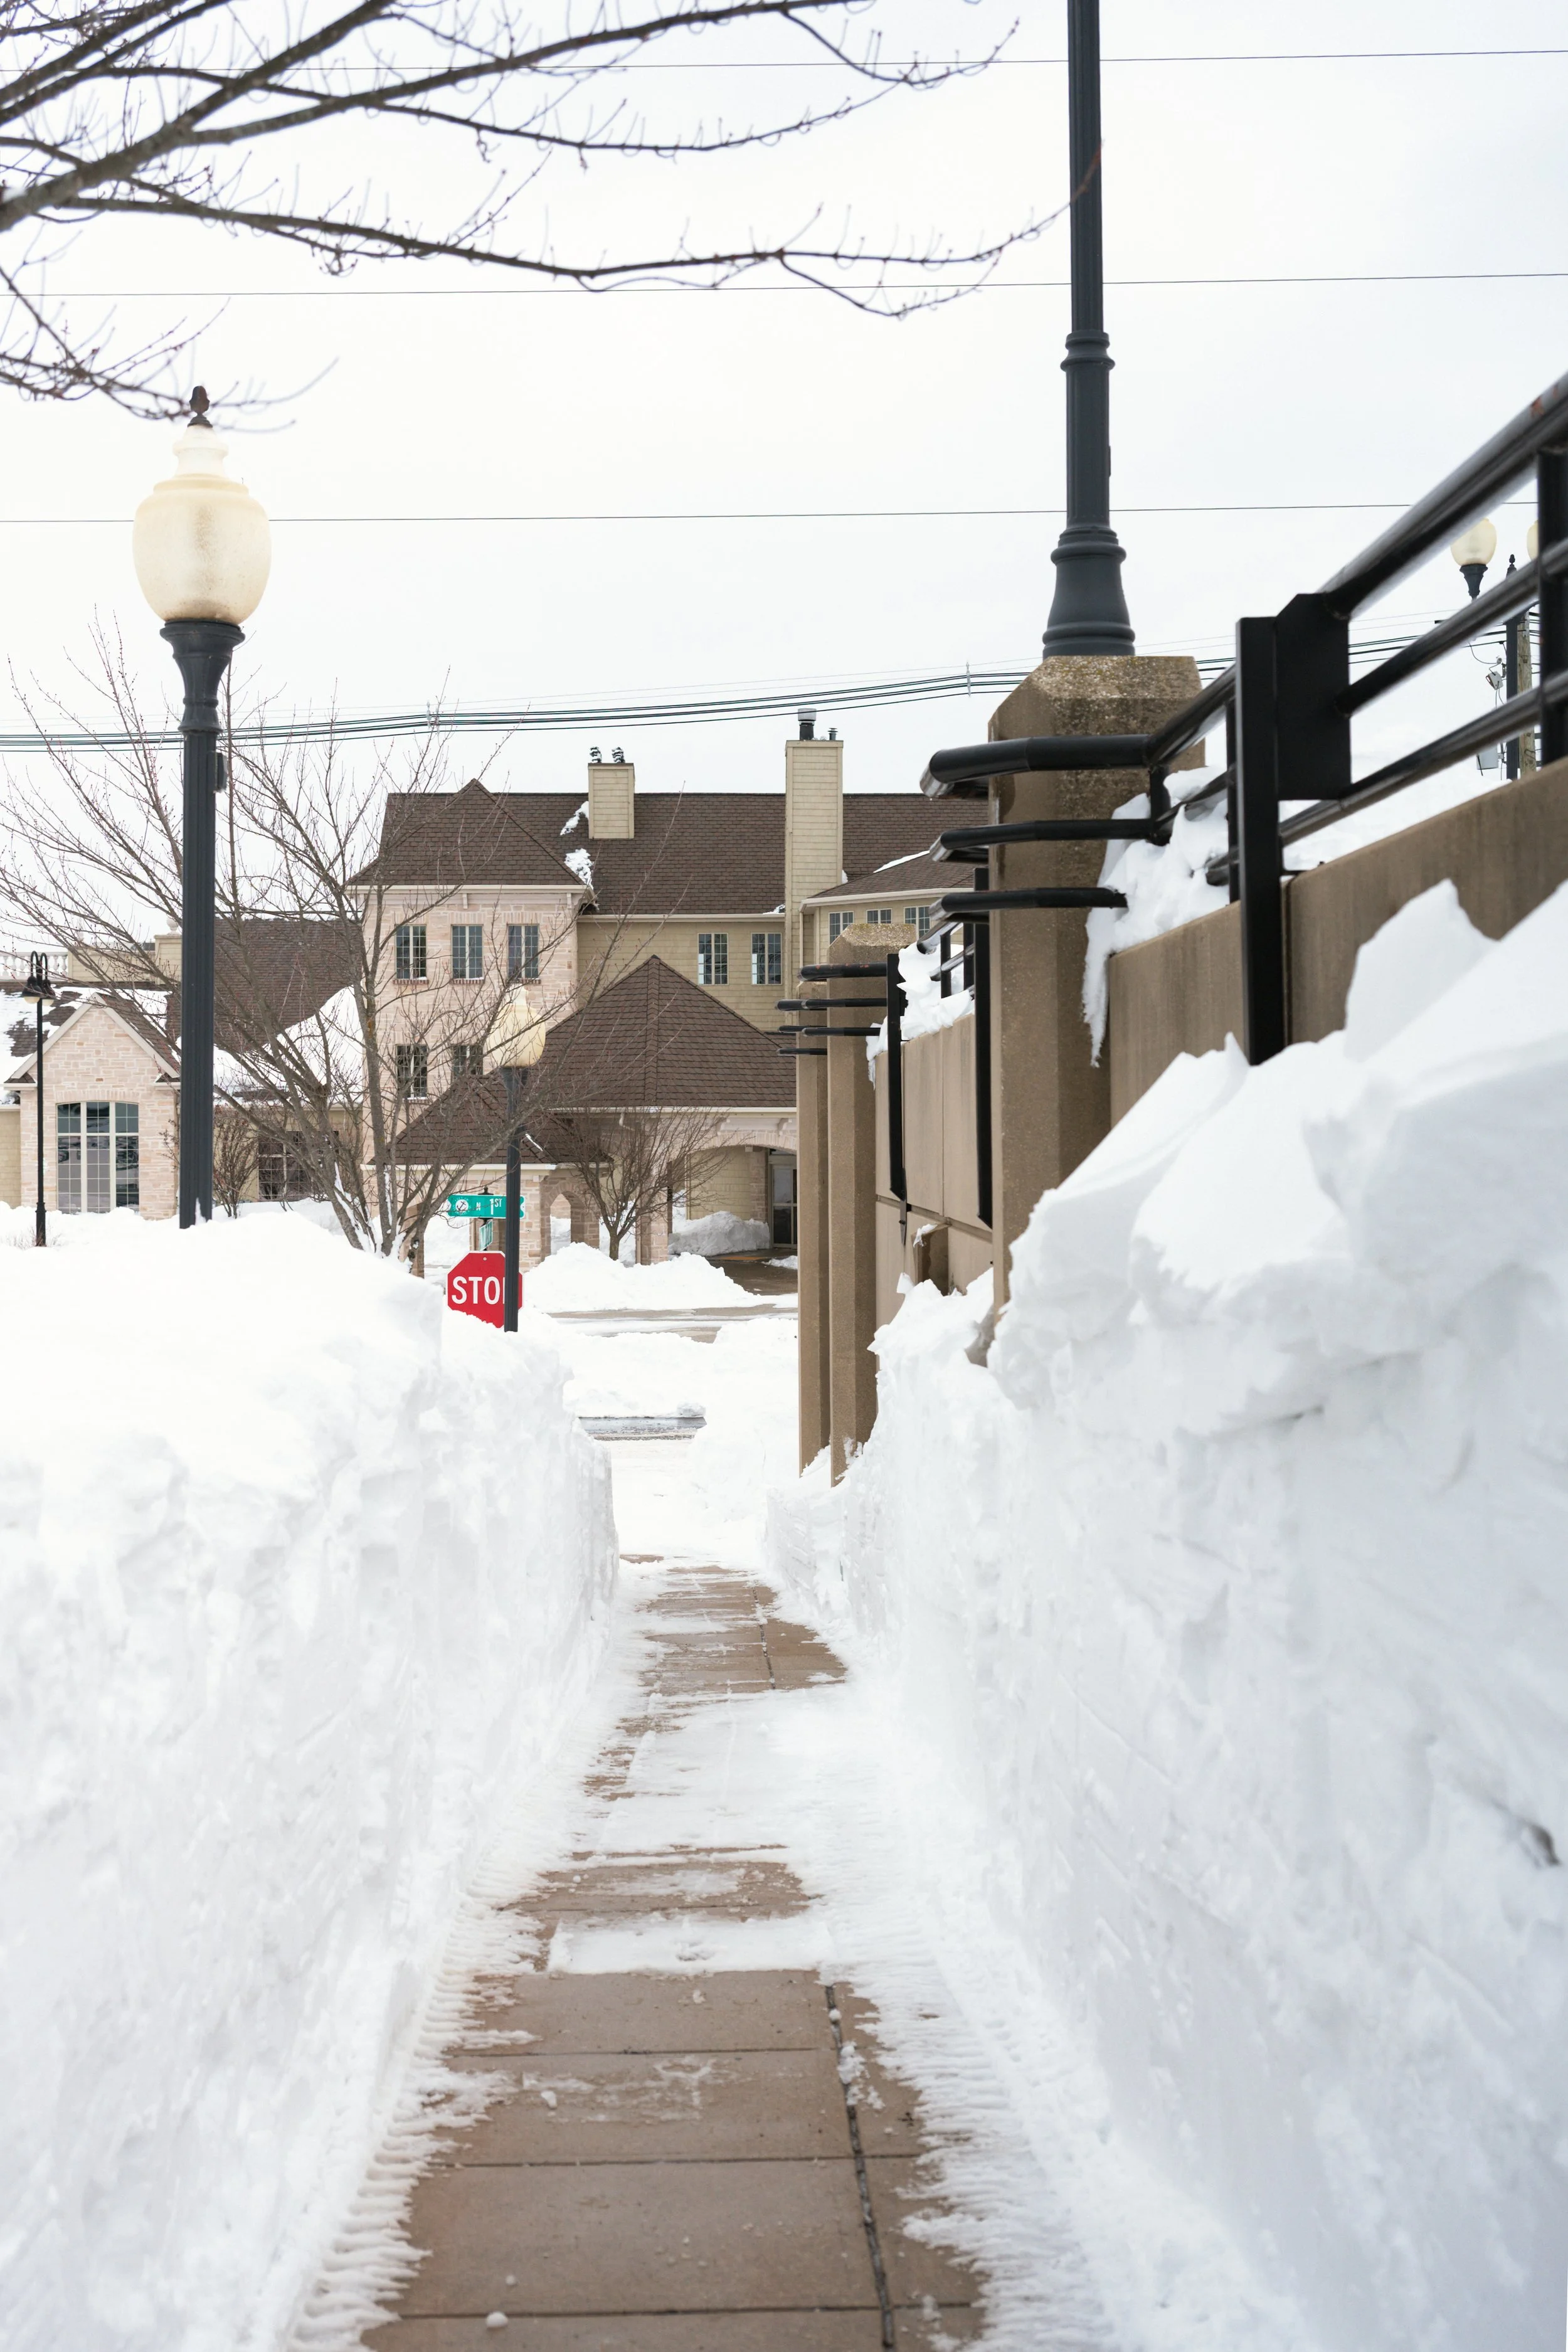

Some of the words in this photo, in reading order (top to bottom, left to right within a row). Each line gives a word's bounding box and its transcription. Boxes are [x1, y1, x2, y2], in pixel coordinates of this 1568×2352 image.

[476, 1202, 481, 1211] N
[489, 1198, 502, 1216] 1ST
[452, 1276, 506, 1305] STO
